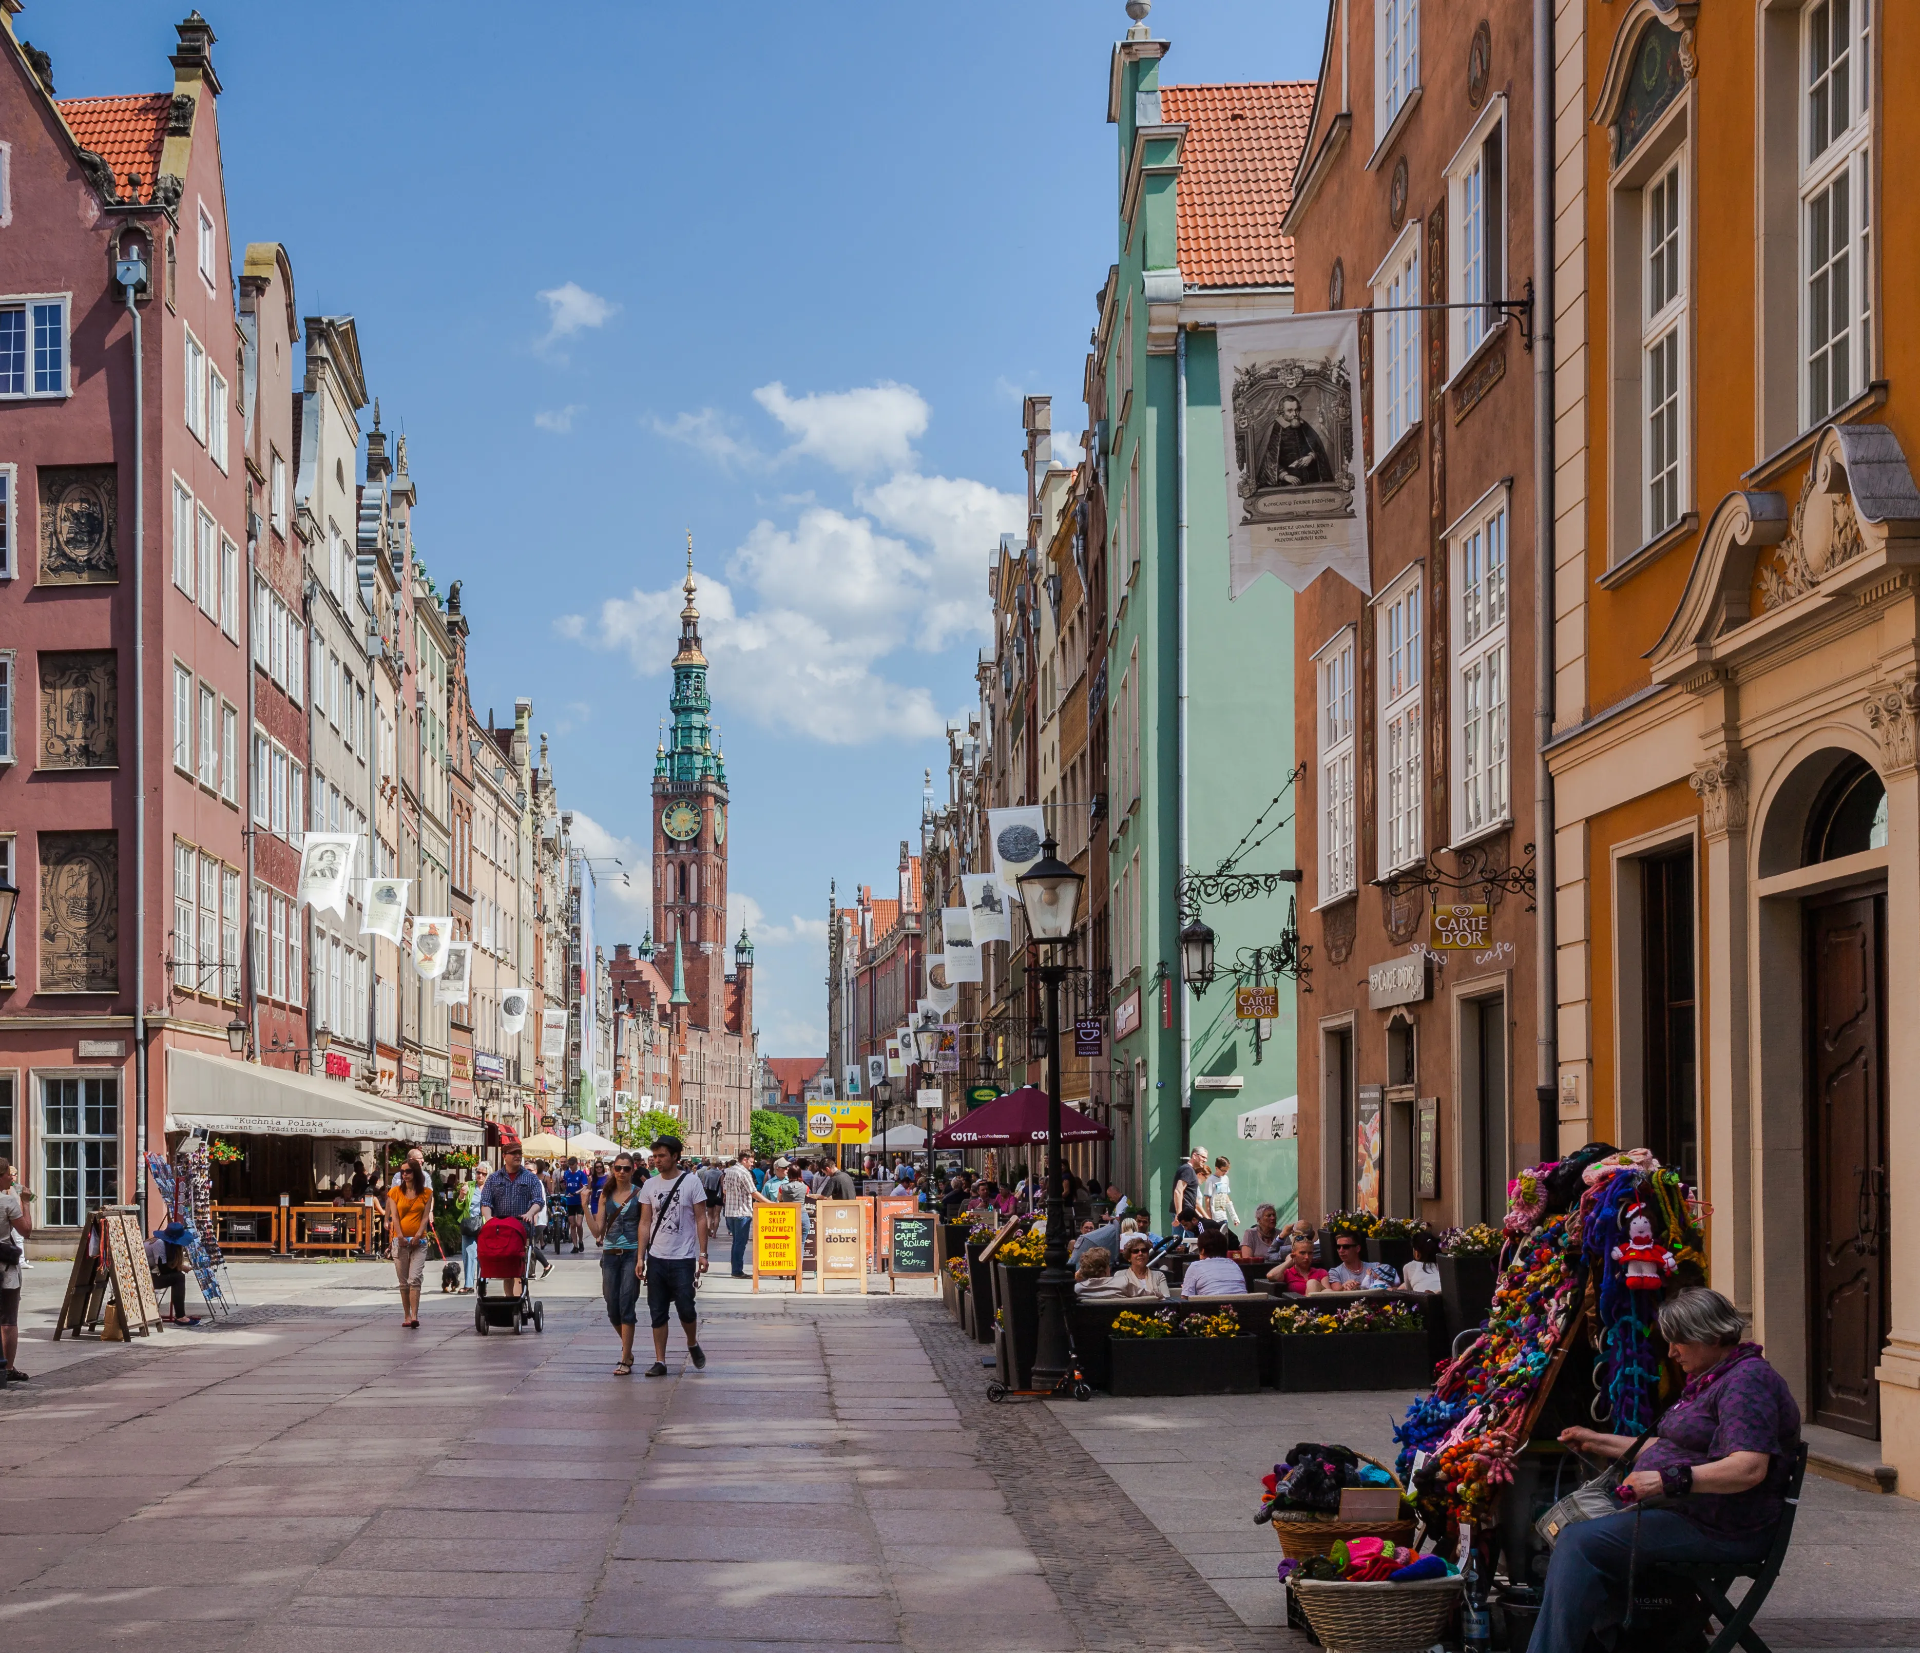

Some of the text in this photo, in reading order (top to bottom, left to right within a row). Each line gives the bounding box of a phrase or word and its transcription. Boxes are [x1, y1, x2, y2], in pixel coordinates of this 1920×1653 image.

[1434, 915, 1488, 932] CARTE
[1441, 930, 1485, 947] D'OR
[1475, 941, 1513, 965] cafe
[1238, 994, 1276, 1007] CARTE
[1243, 1005, 1274, 1017] D'OR
[1076, 1021, 1100, 1029] COSTA
[830, 1107, 838, 1115] 9
[206, 1123, 253, 1131] Restaurant
[354, 1128, 388, 1136] Cuisine
[950, 1132, 978, 1141] COSTA
[825, 1226, 858, 1236] jedzenie
[895, 1232, 918, 1241] CAFE
[825, 1234, 857, 1244] dobre
